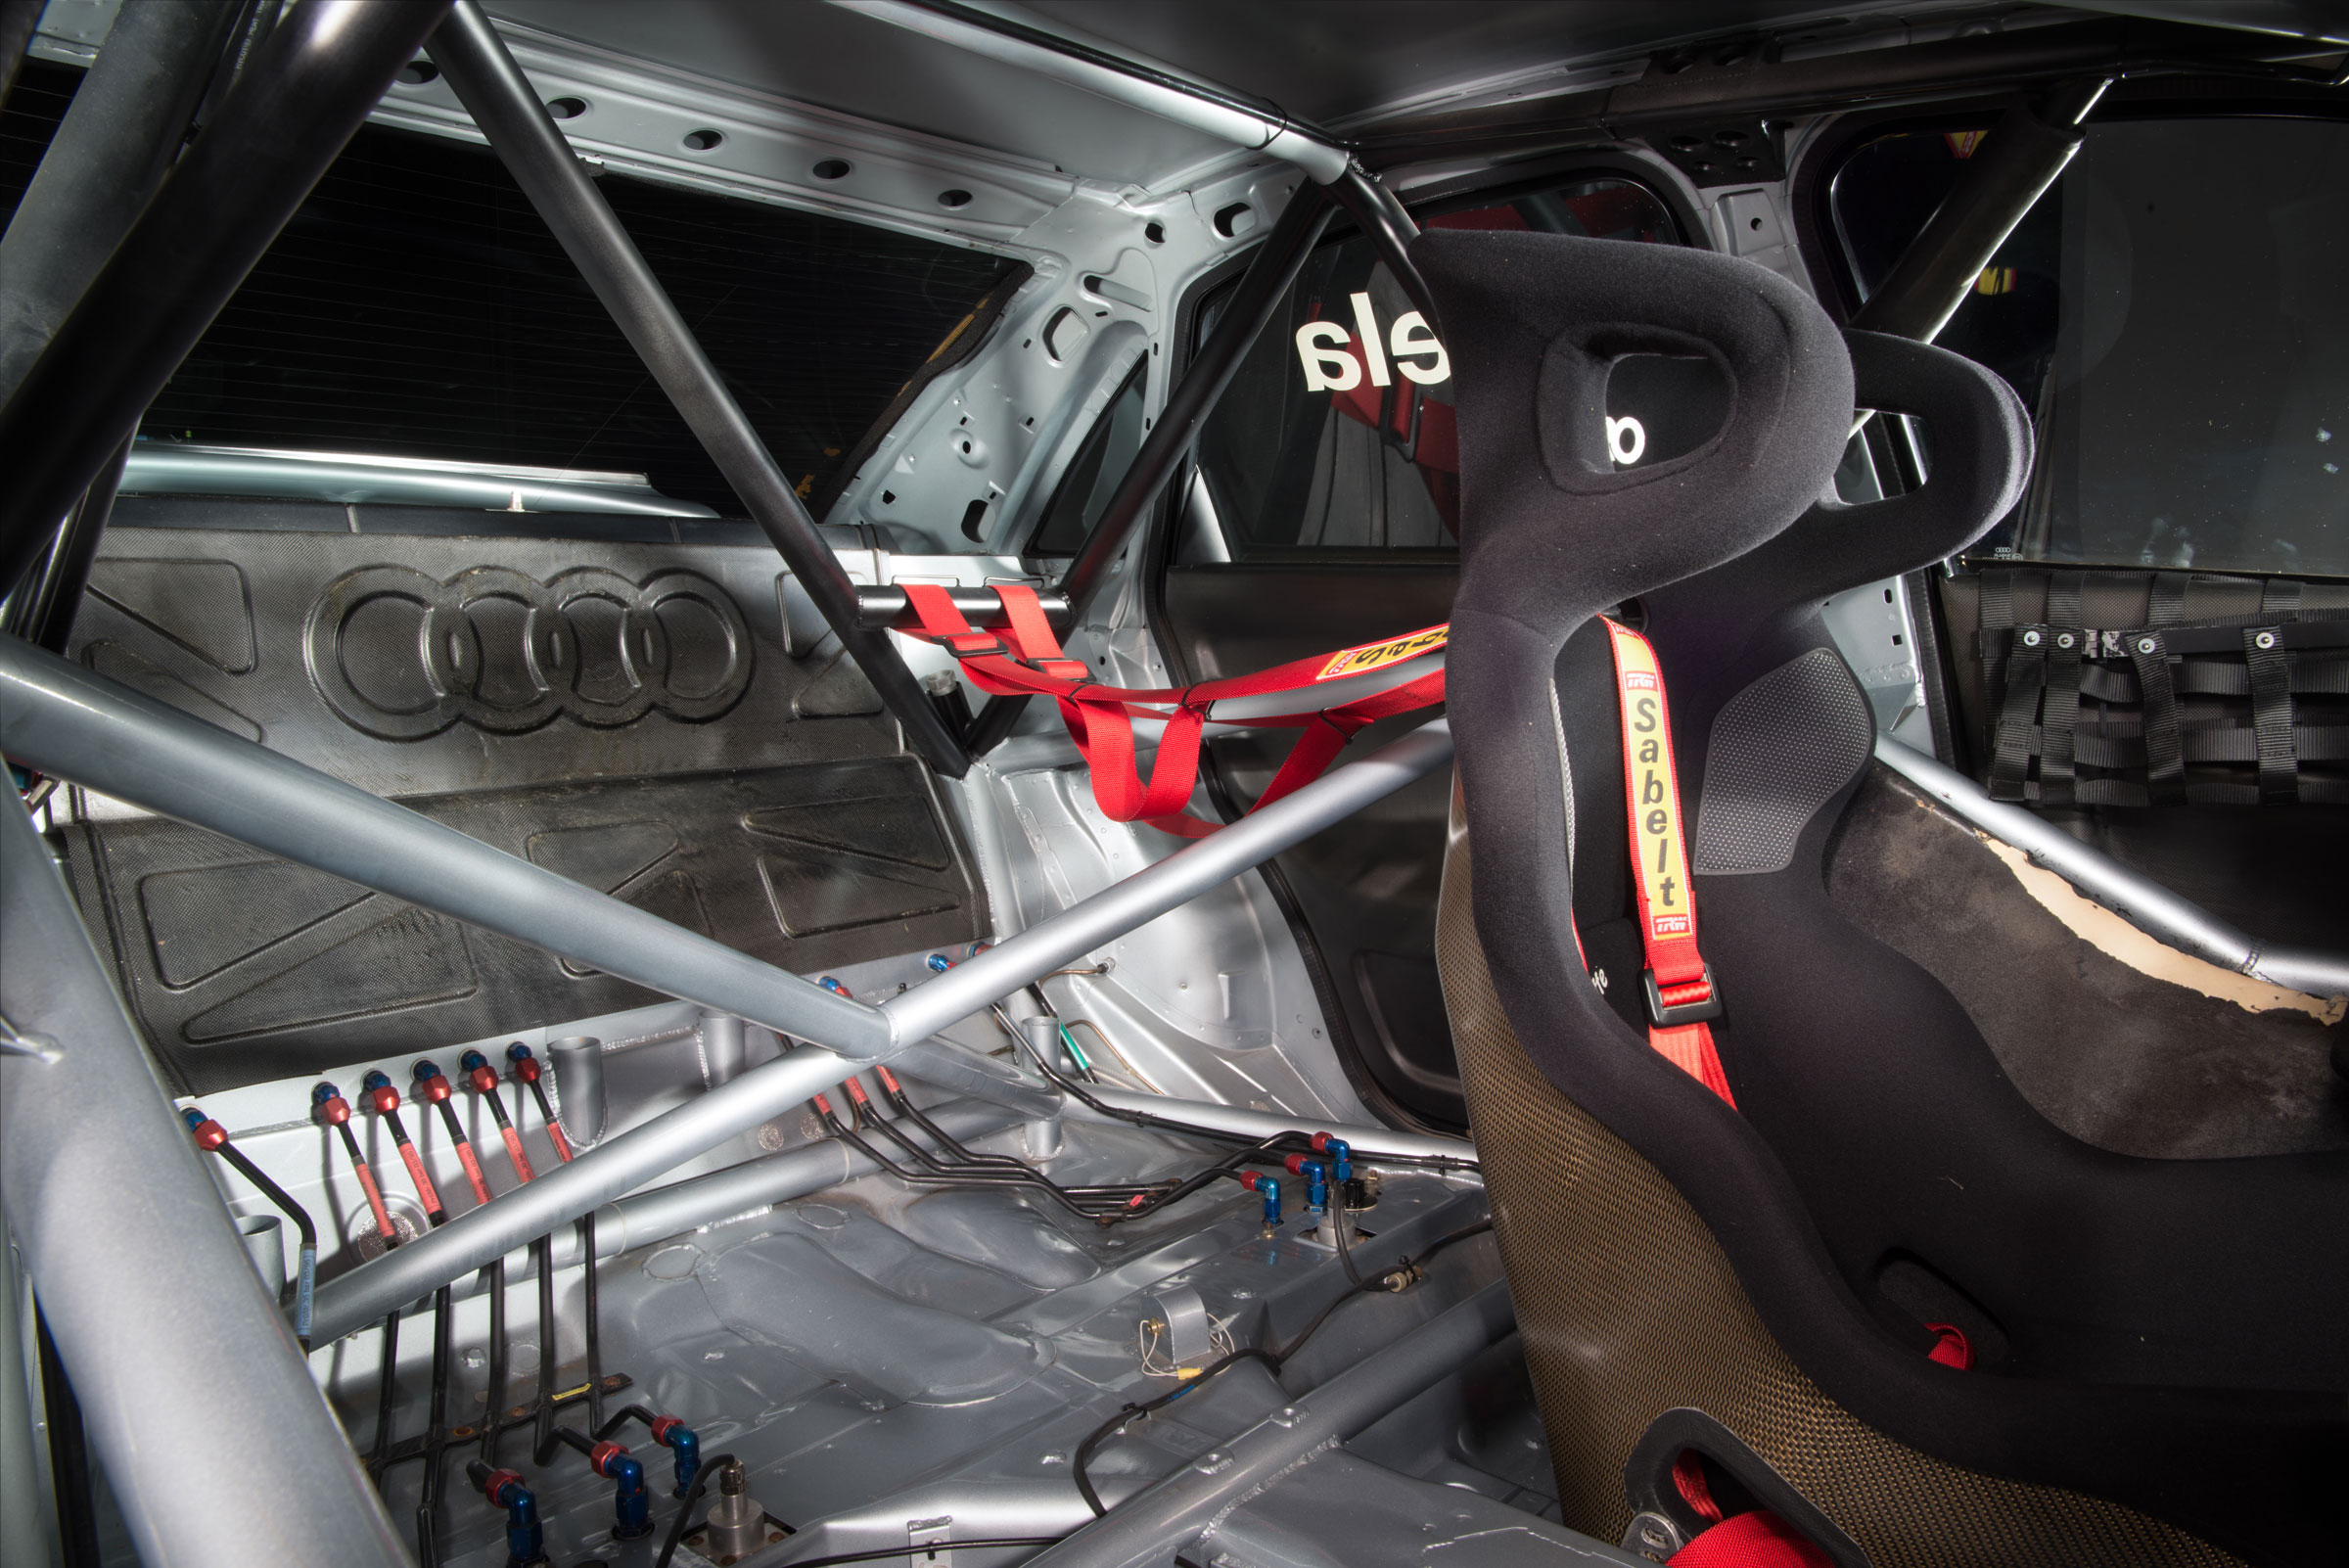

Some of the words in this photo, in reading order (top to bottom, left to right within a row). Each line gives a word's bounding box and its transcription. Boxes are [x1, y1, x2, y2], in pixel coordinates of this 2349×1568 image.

[1355, 630, 1449, 665] Sab
[1626, 672, 1655, 688] TRW
[1634, 697, 1676, 907] Sabelt
[1655, 916, 1687, 932] TRW
